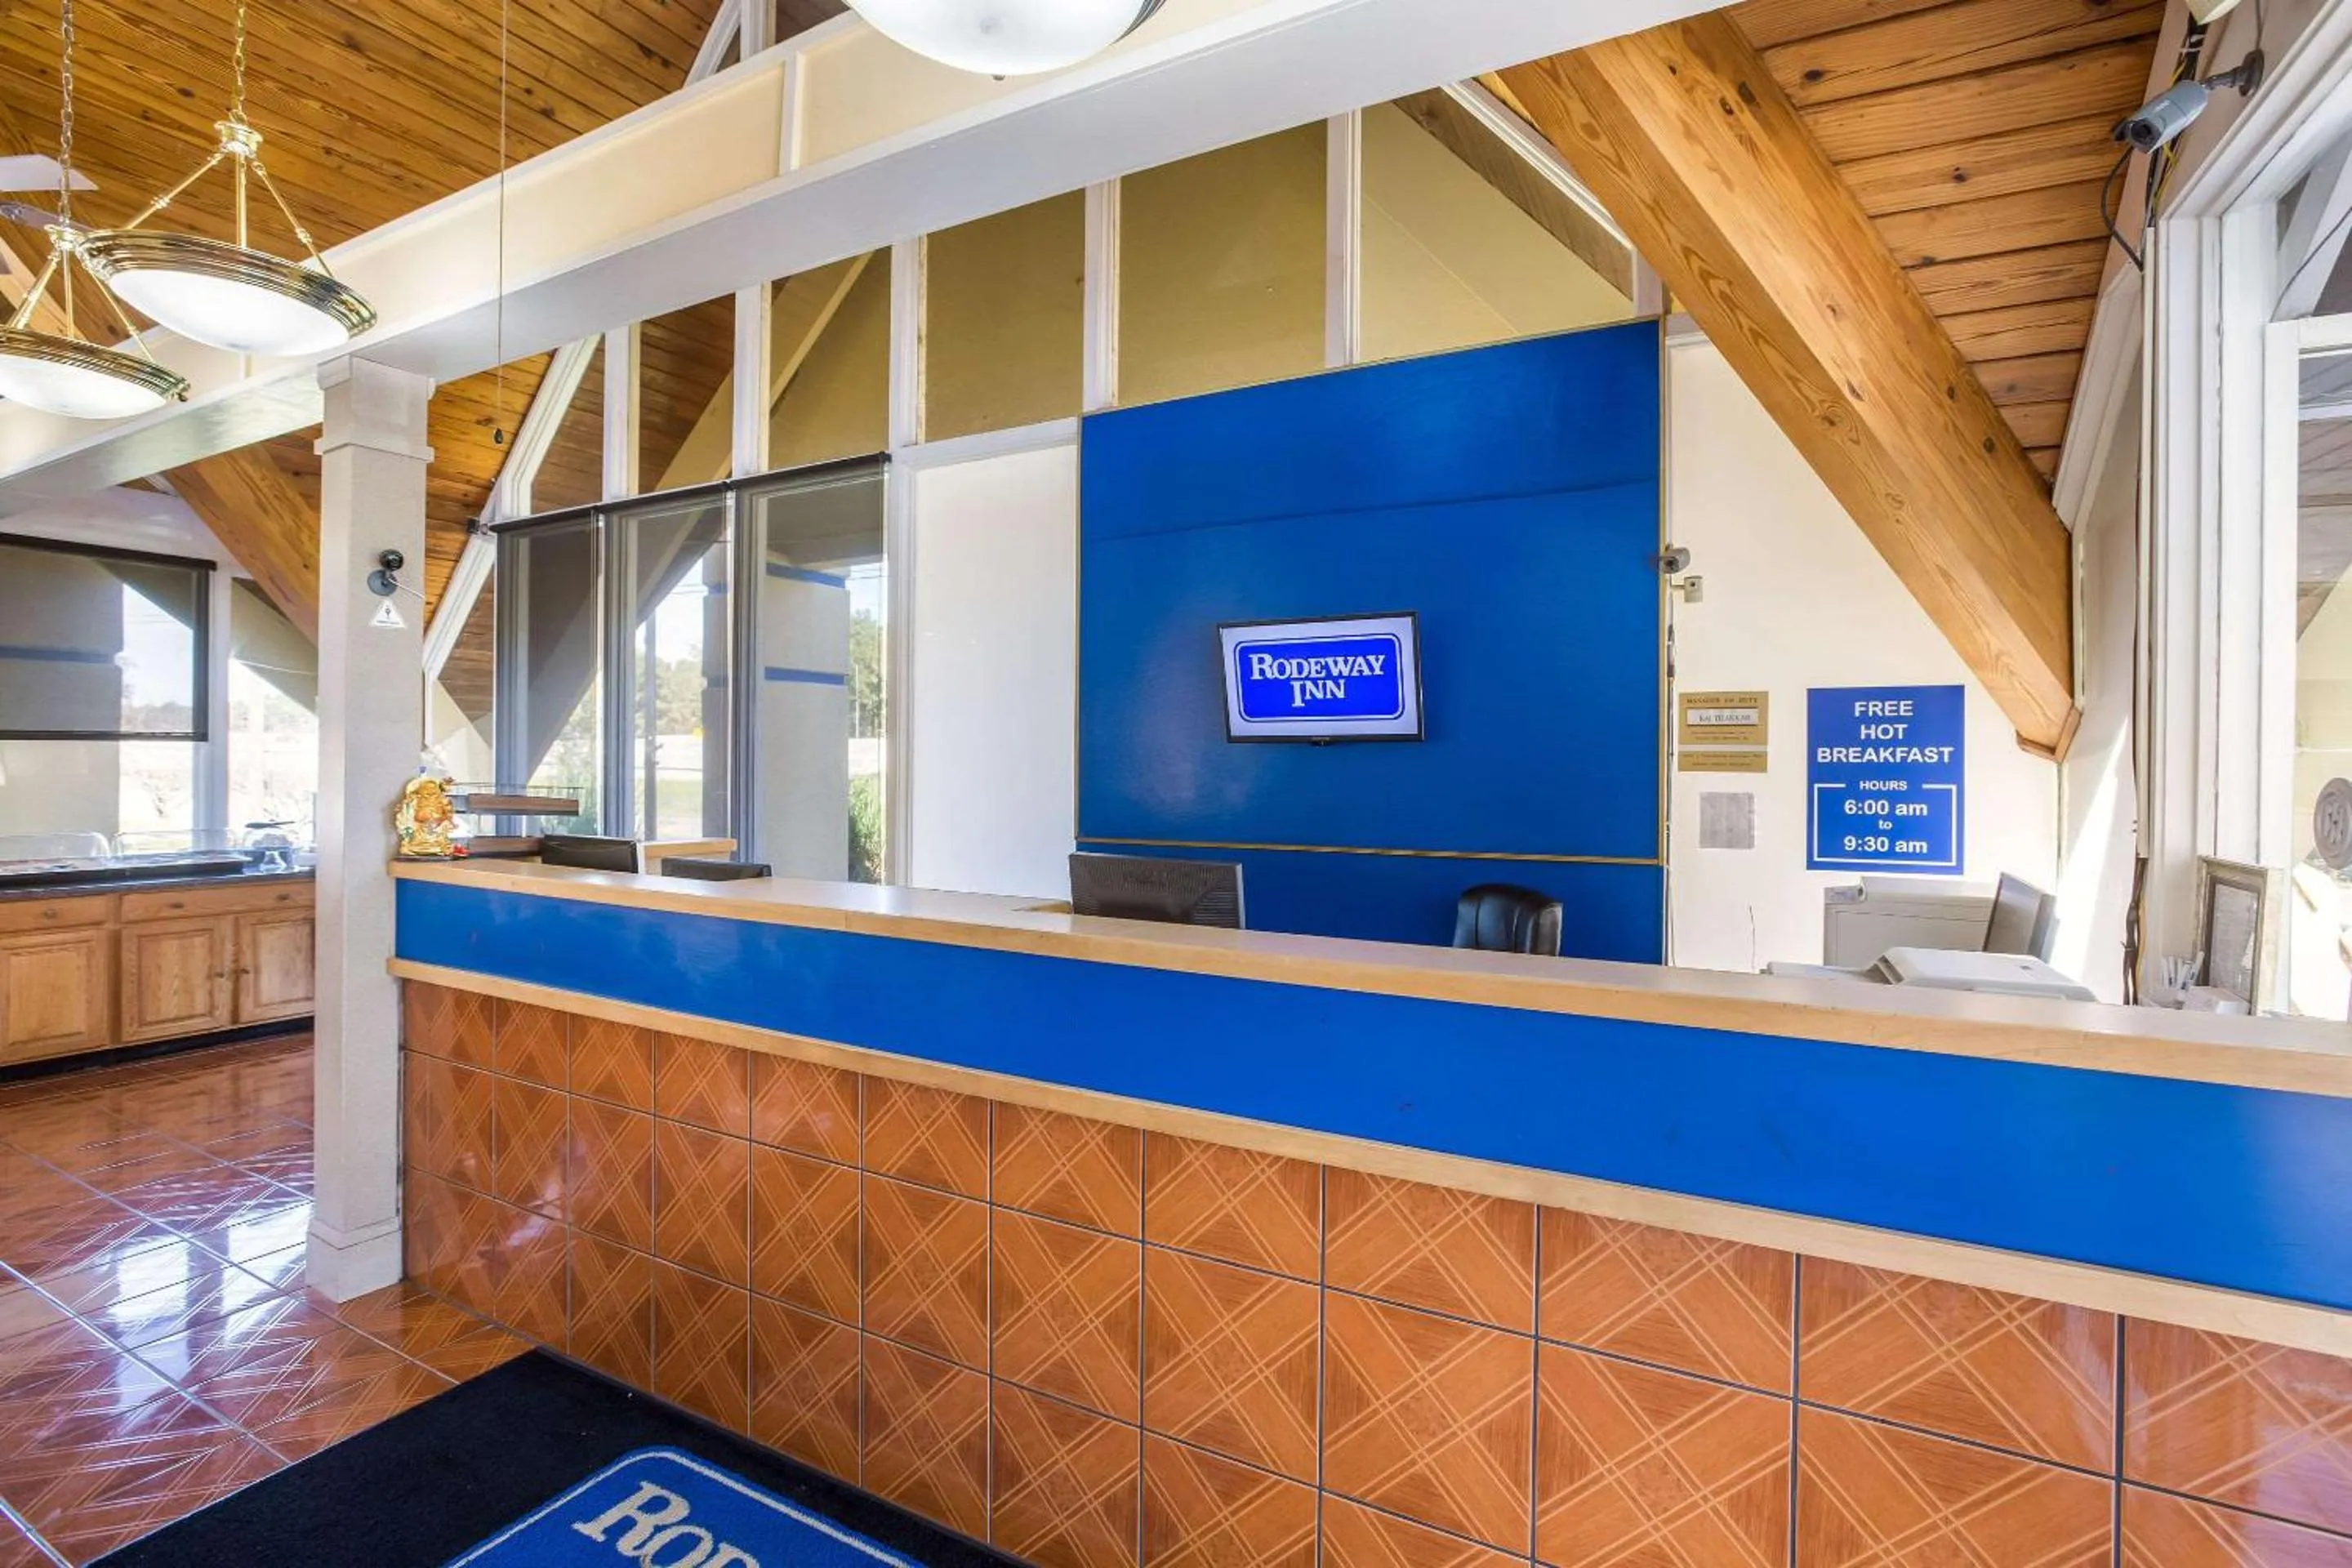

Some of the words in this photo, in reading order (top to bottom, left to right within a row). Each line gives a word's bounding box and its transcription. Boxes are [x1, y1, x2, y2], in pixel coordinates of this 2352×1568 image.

[1249, 653, 1386, 680] RODEWAY
[1290, 679, 1347, 707] INN
[1854, 701, 1914, 717] FREE
[1860, 724, 1908, 740] HOT
[1816, 747, 1954, 764] BREAKFAST
[1859, 781, 1908, 791] HOURS
[1844, 800, 1889, 815] 6:00
[1895, 803, 1928, 816] am
[1878, 819, 1892, 831] to
[1843, 836, 1889, 852] 9:30
[1895, 840, 1928, 853] am
